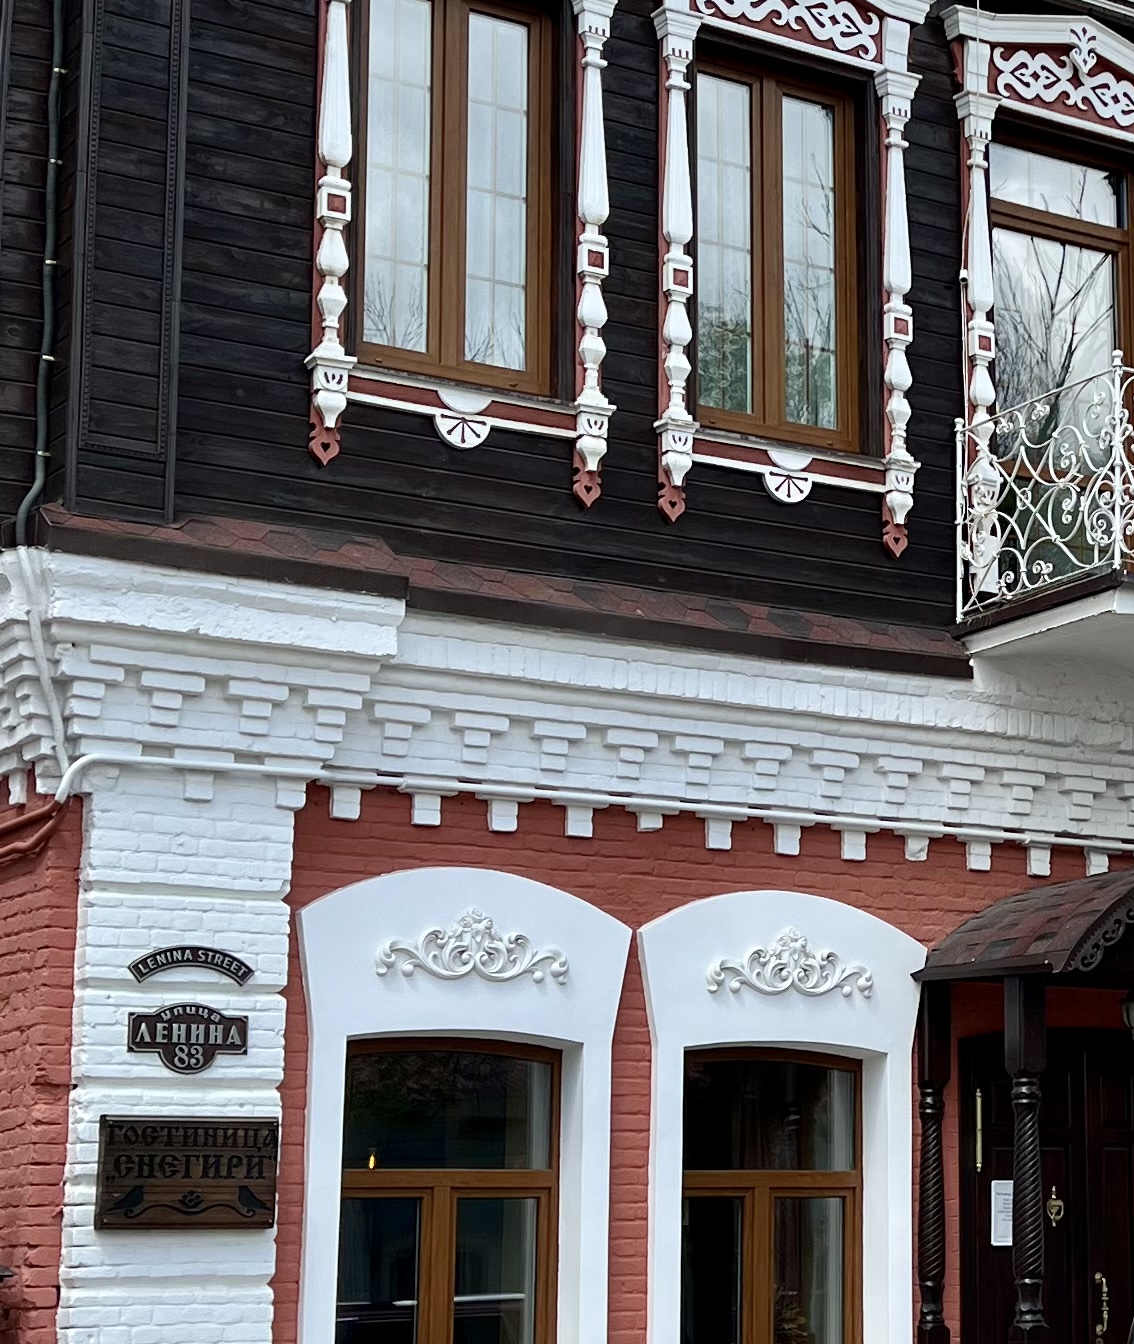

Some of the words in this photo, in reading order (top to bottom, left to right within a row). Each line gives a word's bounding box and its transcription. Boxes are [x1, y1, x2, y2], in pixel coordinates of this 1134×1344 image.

[138, 949, 193, 974] LENINA
[197, 950, 249, 977] STREET
[160, 1006, 221, 1023] улица
[135, 1022, 242, 1045] ЛЕНИНА
[173, 1044, 204, 1068] 83
[107, 1124, 278, 1152] ГОСТИНИЦА
